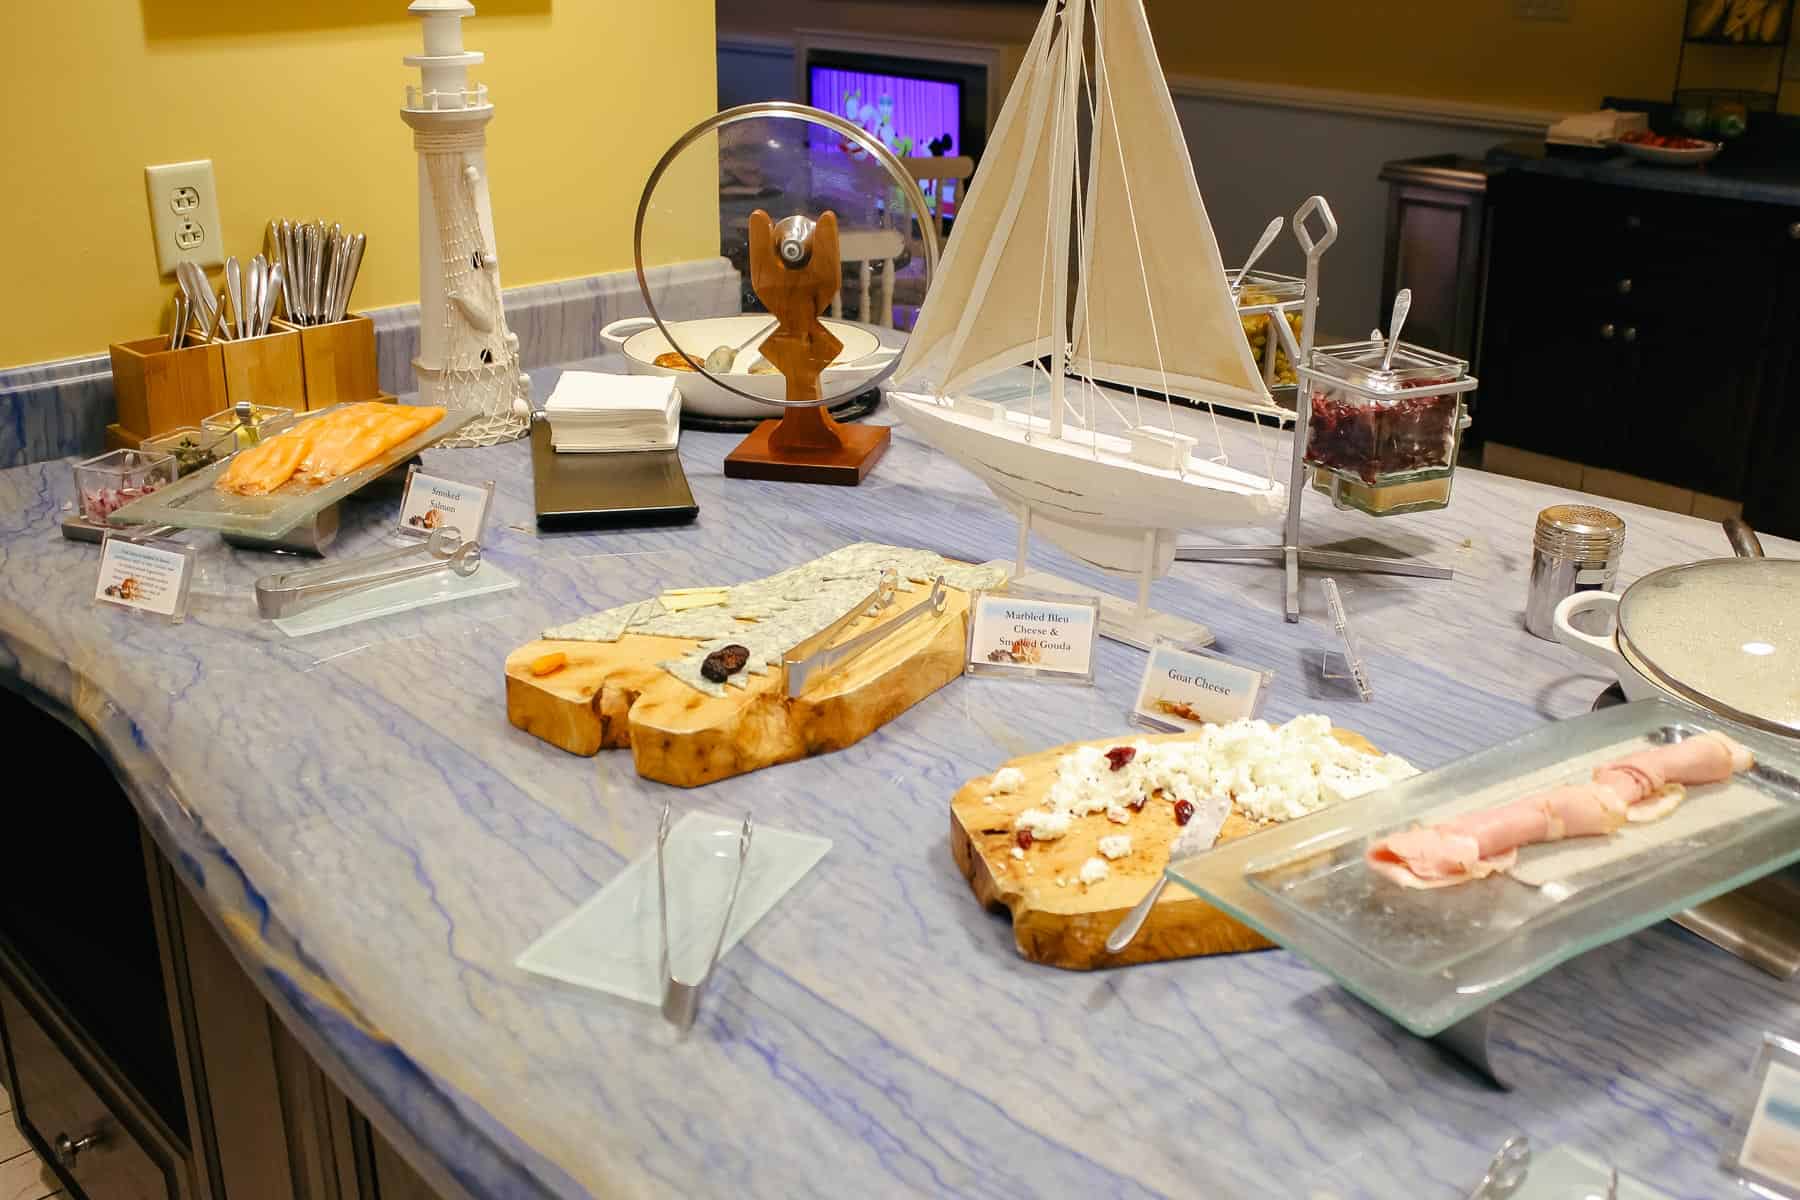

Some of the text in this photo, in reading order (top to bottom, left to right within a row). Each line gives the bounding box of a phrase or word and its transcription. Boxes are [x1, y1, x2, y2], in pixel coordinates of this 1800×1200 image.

[431, 487, 462, 501] Smoked
[430, 499, 456, 513] Salmon
[1005, 610, 1045, 622] Marbled
[1014, 624, 1059, 636] Cheese &
[999, 637, 1071, 651] Smoked Gouda
[1168, 668, 1231, 696] Goat Cheese
